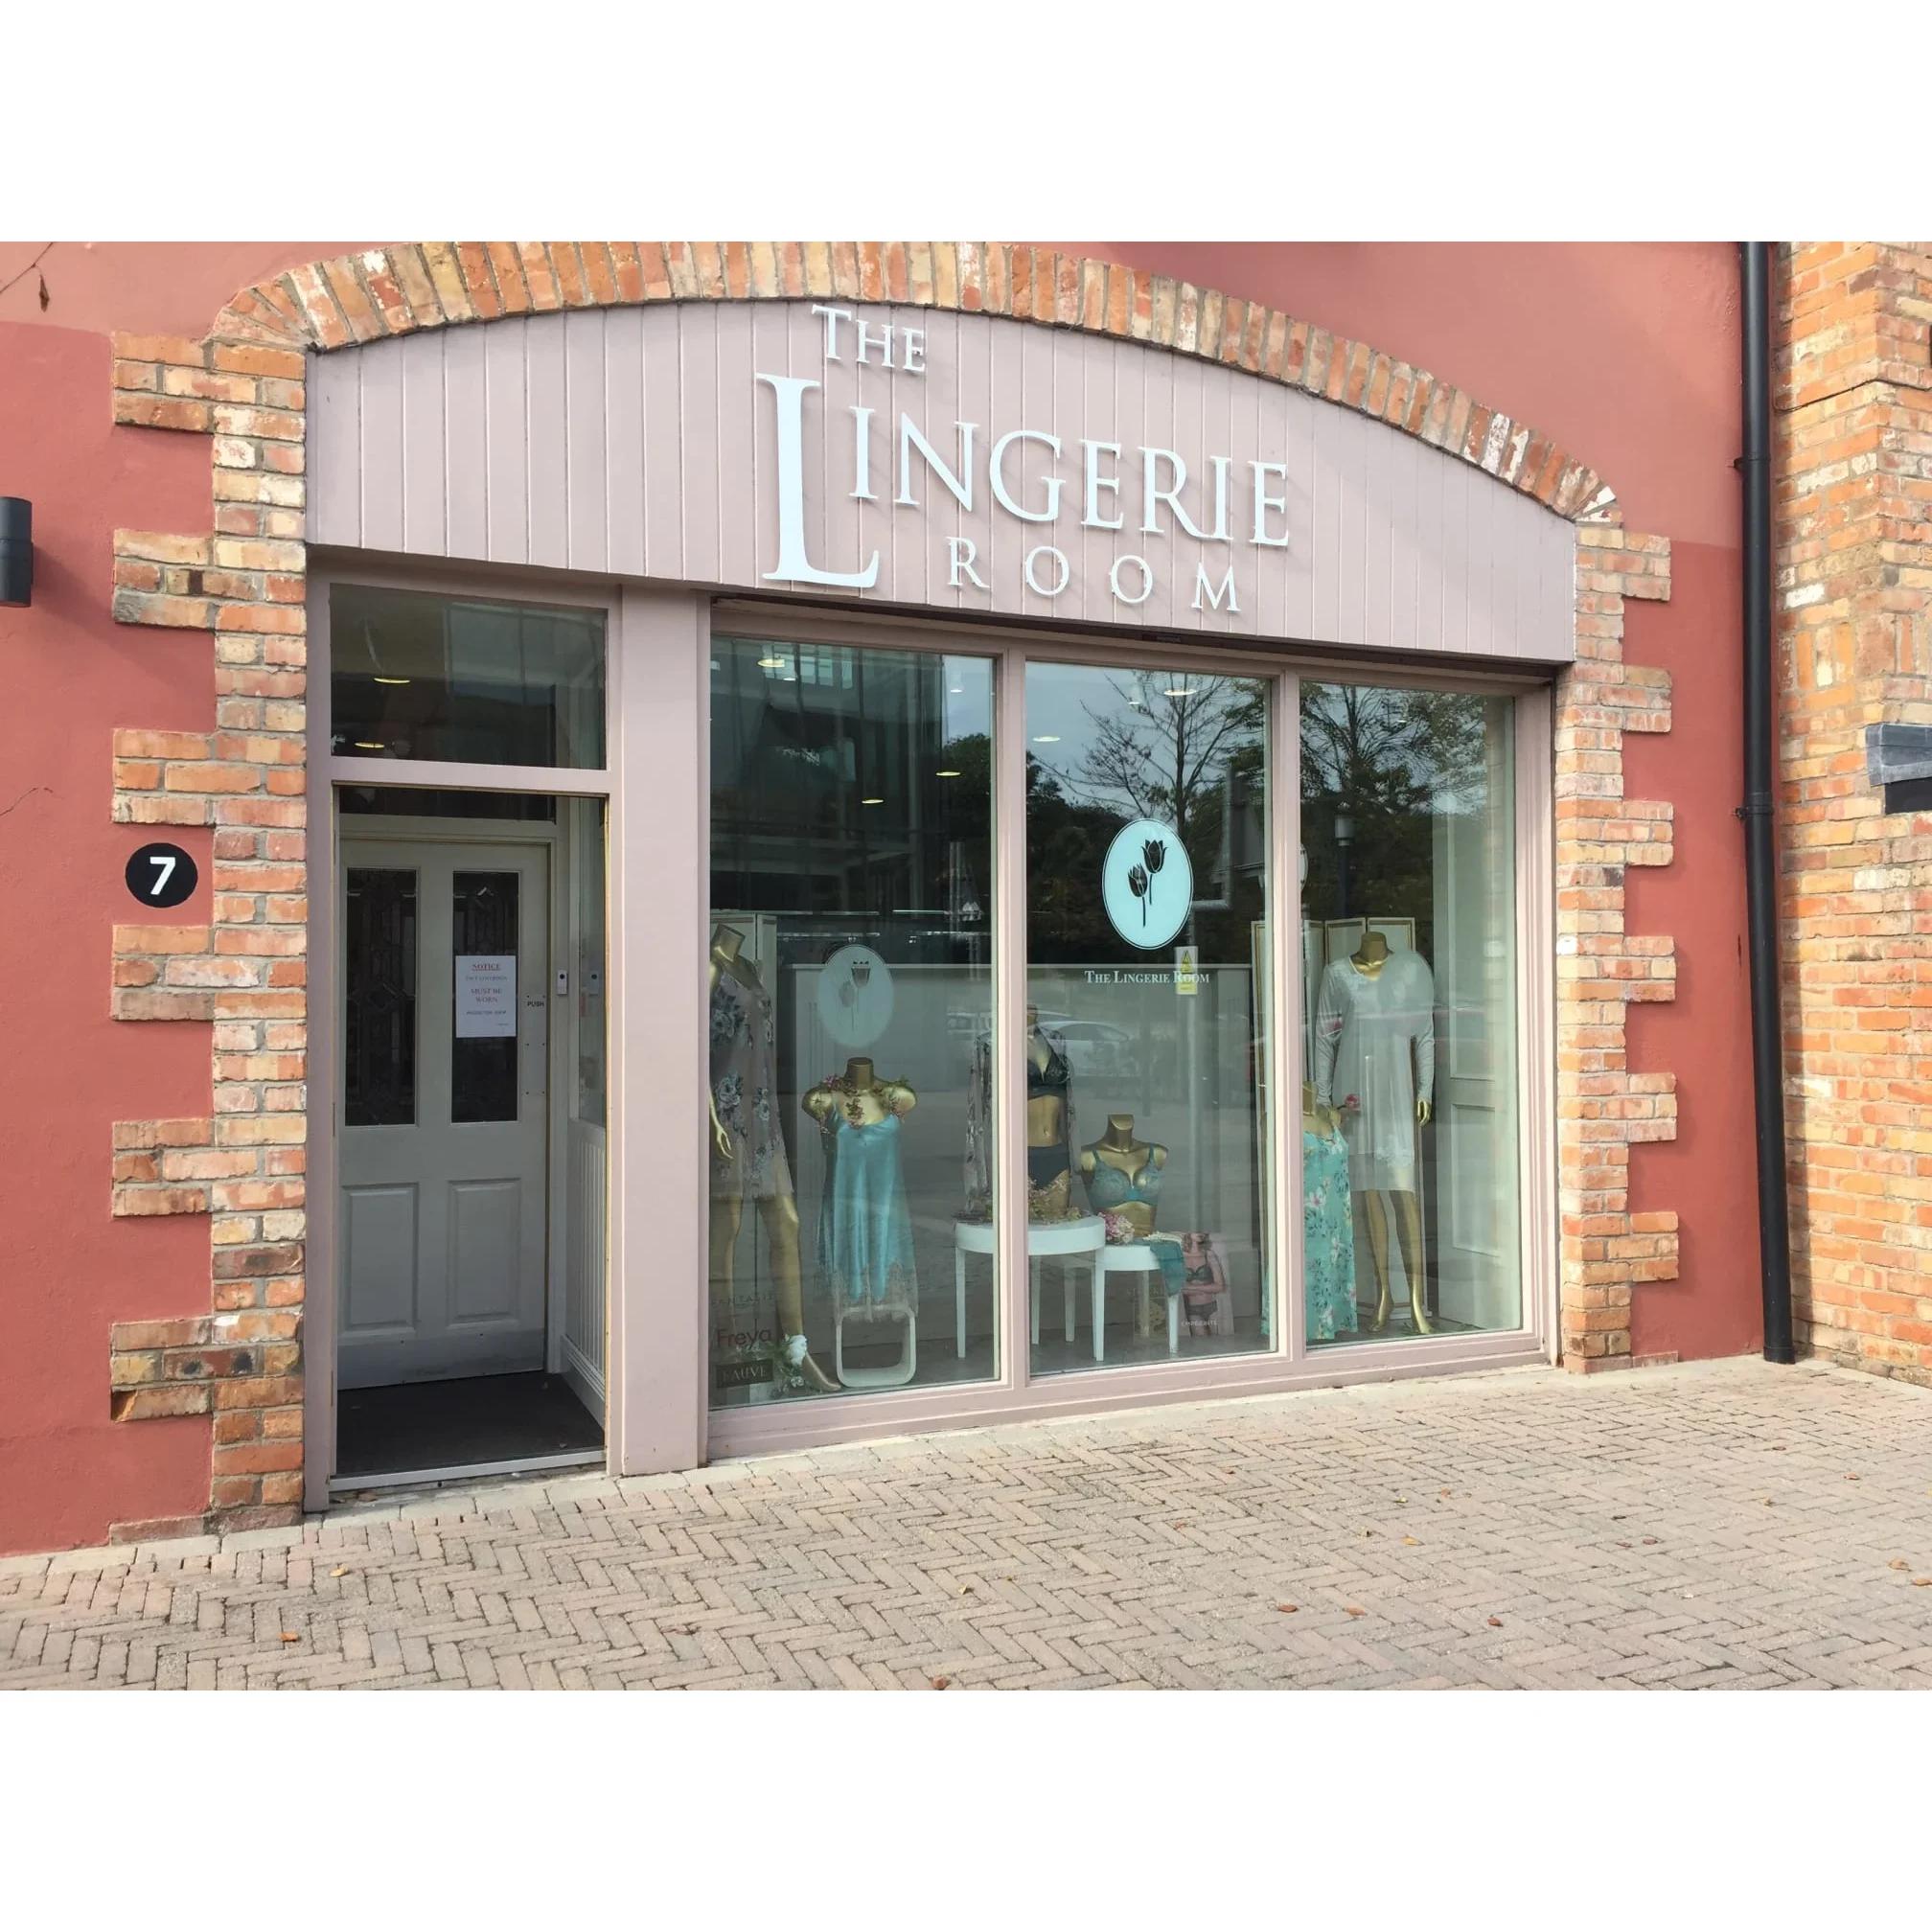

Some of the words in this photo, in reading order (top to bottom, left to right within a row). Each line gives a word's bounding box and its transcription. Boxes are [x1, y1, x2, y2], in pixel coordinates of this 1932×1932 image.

[812, 305, 927, 373] THE
[755, 372, 1290, 588] LINGERIE
[945, 536, 1241, 612] ROOM
[150, 856, 176, 895] 7
[1084, 970, 1112, 983] THE
[1114, 970, 1170, 983] LINGERIE
[1173, 970, 1209, 983] ROOM
[717, 1326, 771, 1349] Freya
